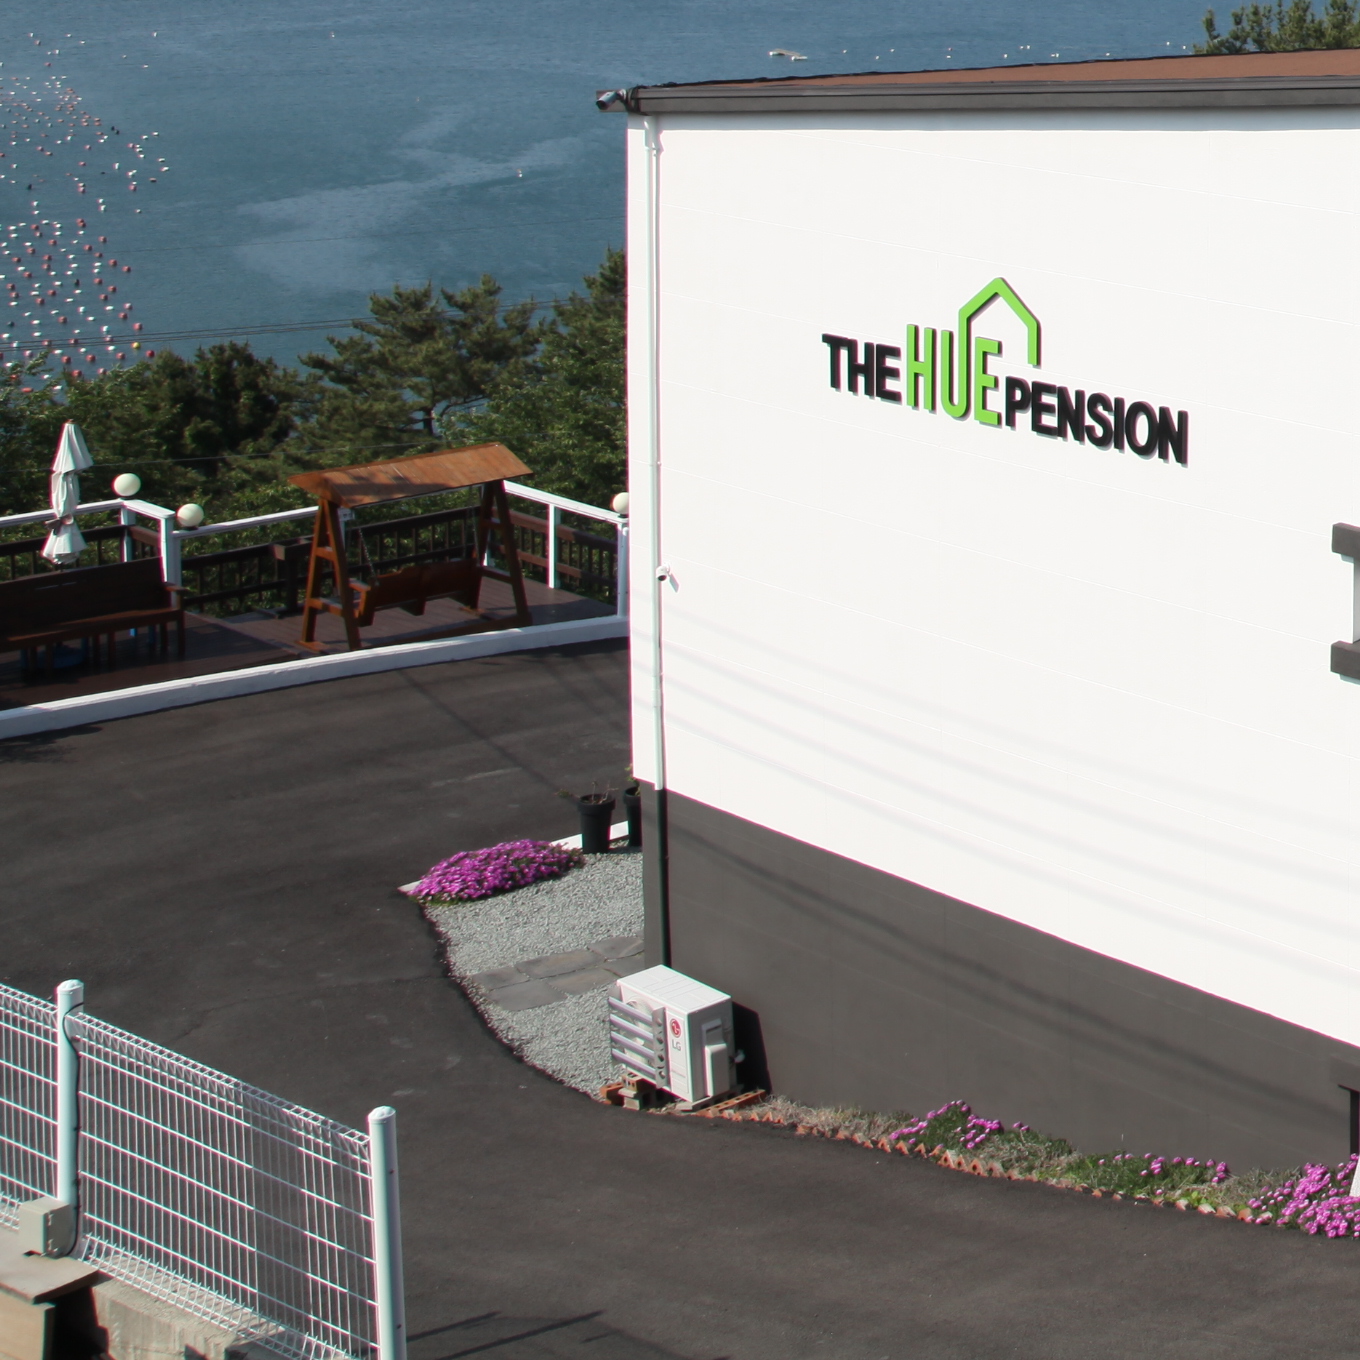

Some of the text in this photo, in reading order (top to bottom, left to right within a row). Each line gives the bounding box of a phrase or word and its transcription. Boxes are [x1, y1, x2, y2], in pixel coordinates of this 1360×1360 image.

[821, 308, 1189, 466] THE HUE PENSION
[671, 1039, 682, 1052] LG
